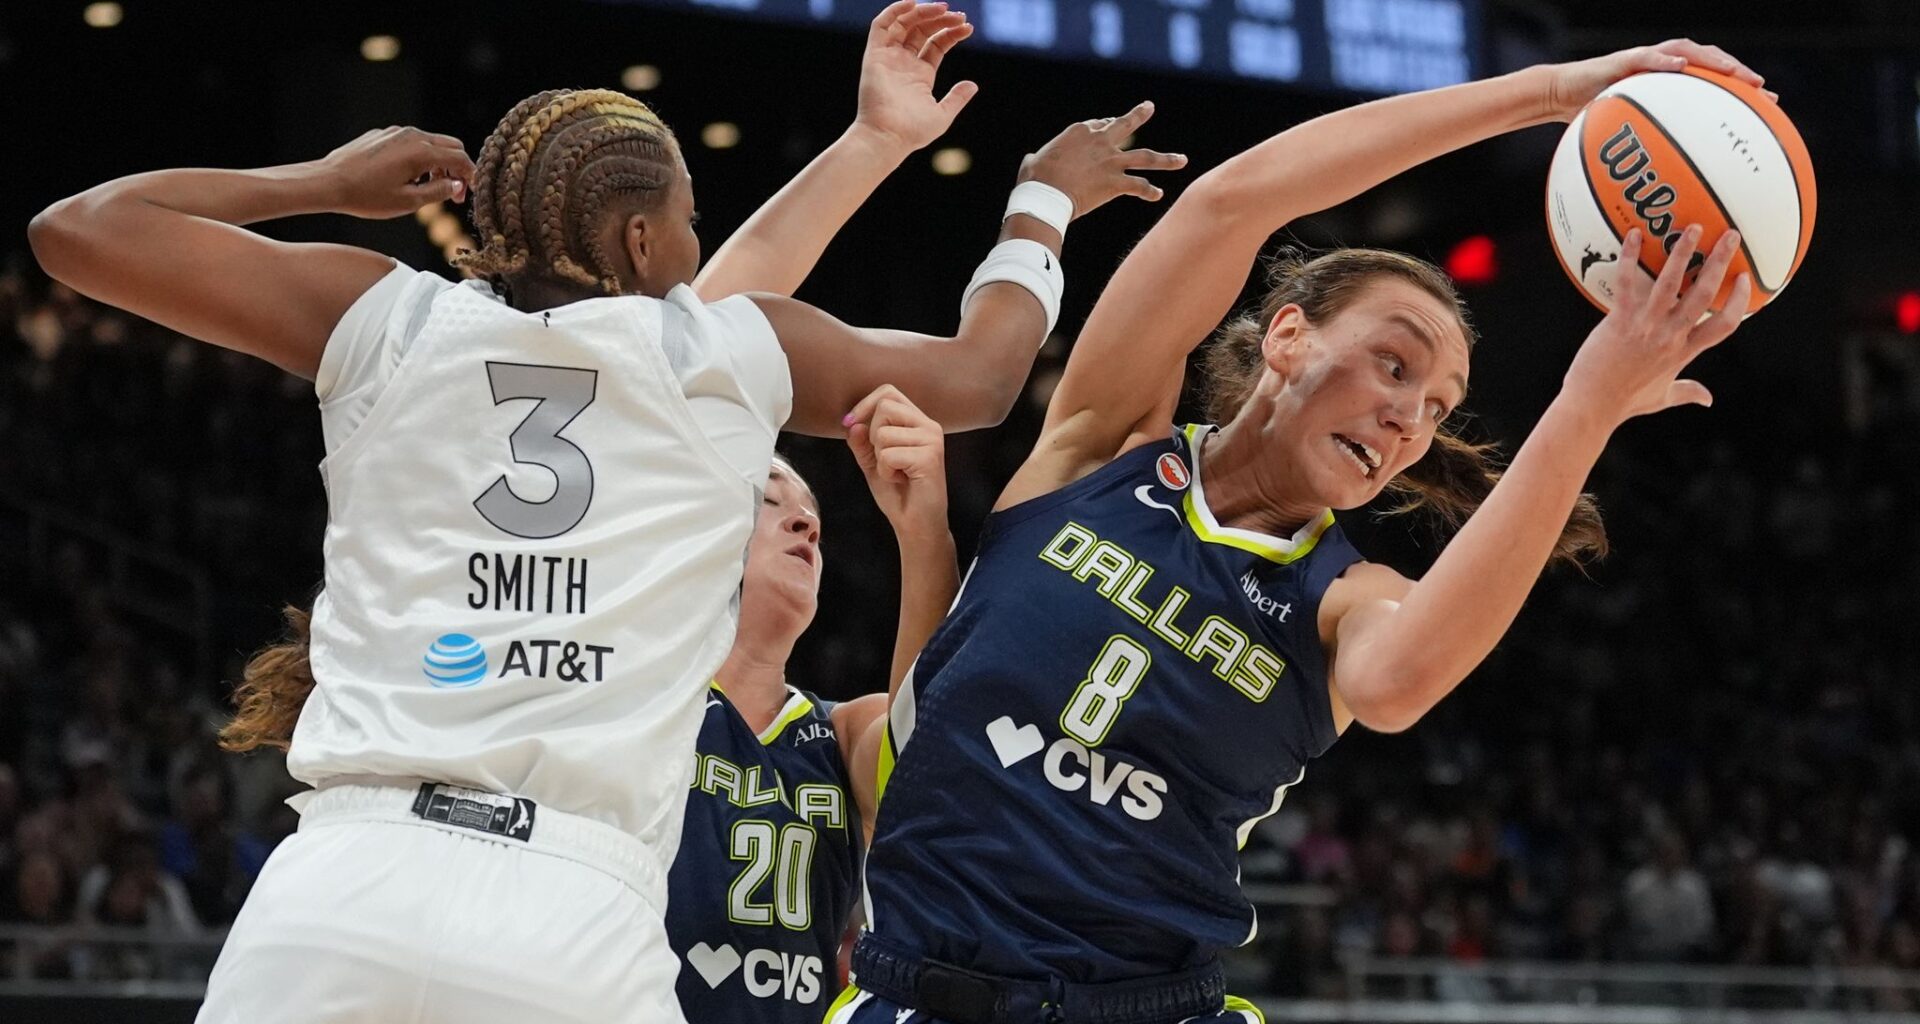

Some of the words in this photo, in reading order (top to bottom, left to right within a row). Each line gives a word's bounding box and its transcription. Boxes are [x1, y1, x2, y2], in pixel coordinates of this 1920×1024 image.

[1599, 121, 1706, 297] Wilso
[473, 361, 599, 540] 3
[468, 552, 588, 615] SMITH
[1038, 521, 1287, 703] DALLAS
[1240, 569, 1292, 623] Albert
[498, 640, 615, 684] AT&T
[1059, 634, 1152, 748] 8
[1043, 738, 1168, 821] CVS
[727, 819, 817, 931] 20
[743, 949, 823, 1004] CVS
